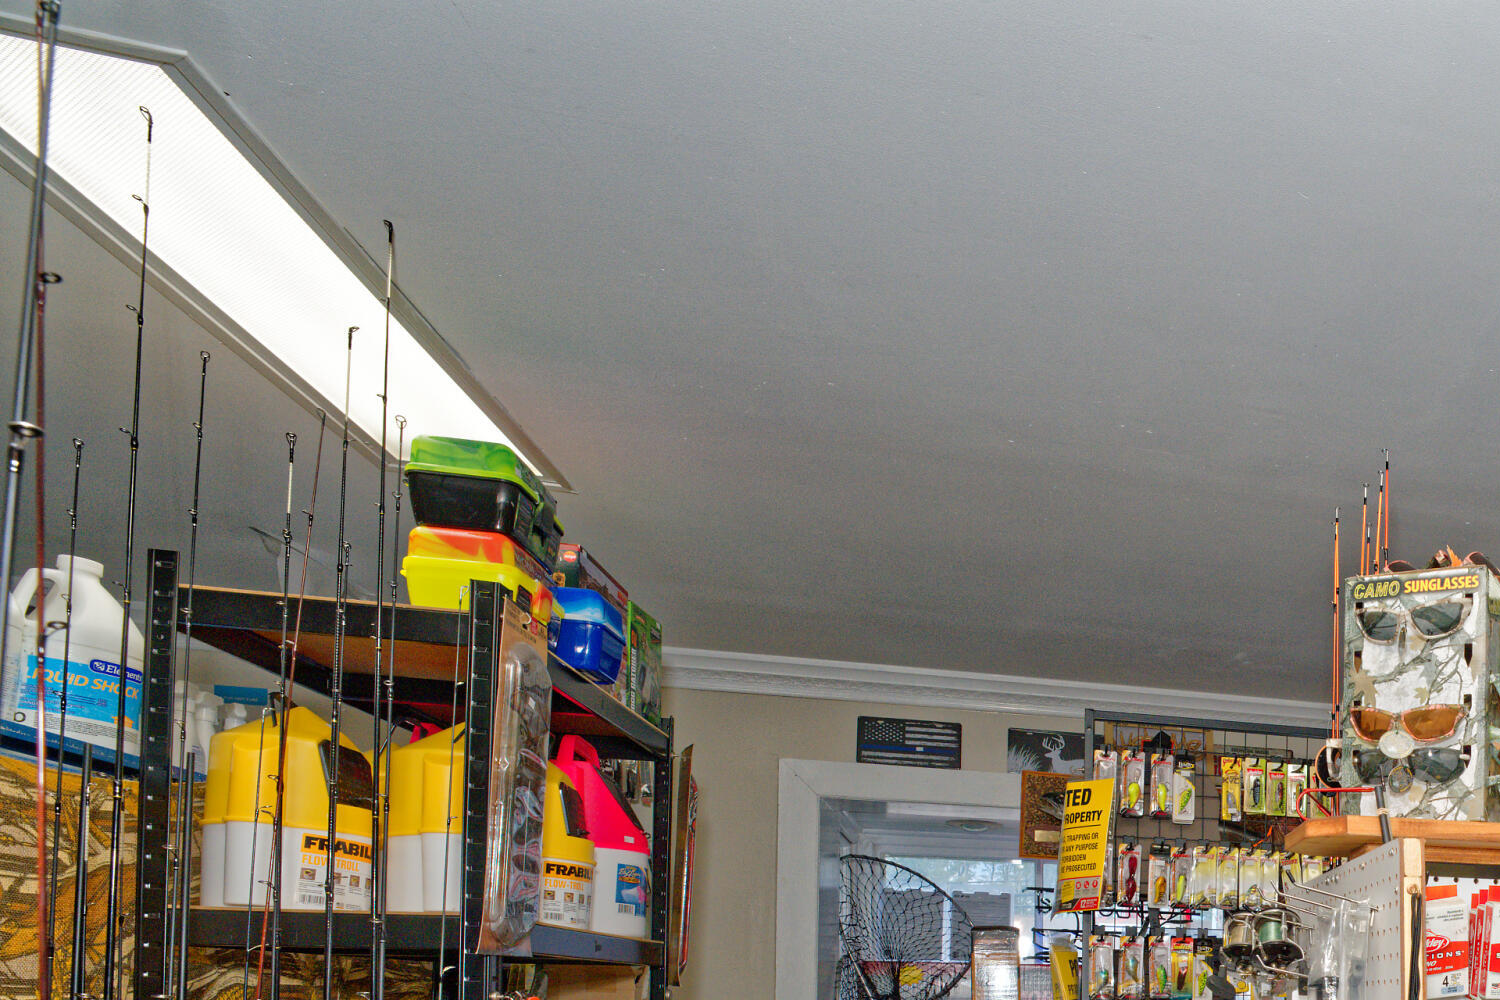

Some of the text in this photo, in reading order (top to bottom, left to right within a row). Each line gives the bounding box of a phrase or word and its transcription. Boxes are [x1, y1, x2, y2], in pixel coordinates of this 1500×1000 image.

[1353, 574, 1480, 600] CAMO SUNGLASSES
[1066, 787, 1092, 808] TED
[304, 836, 373, 860] FRABIL
[1062, 854, 1087, 865] ORBIDDEN
[1426, 951, 1463, 961] TIONS
